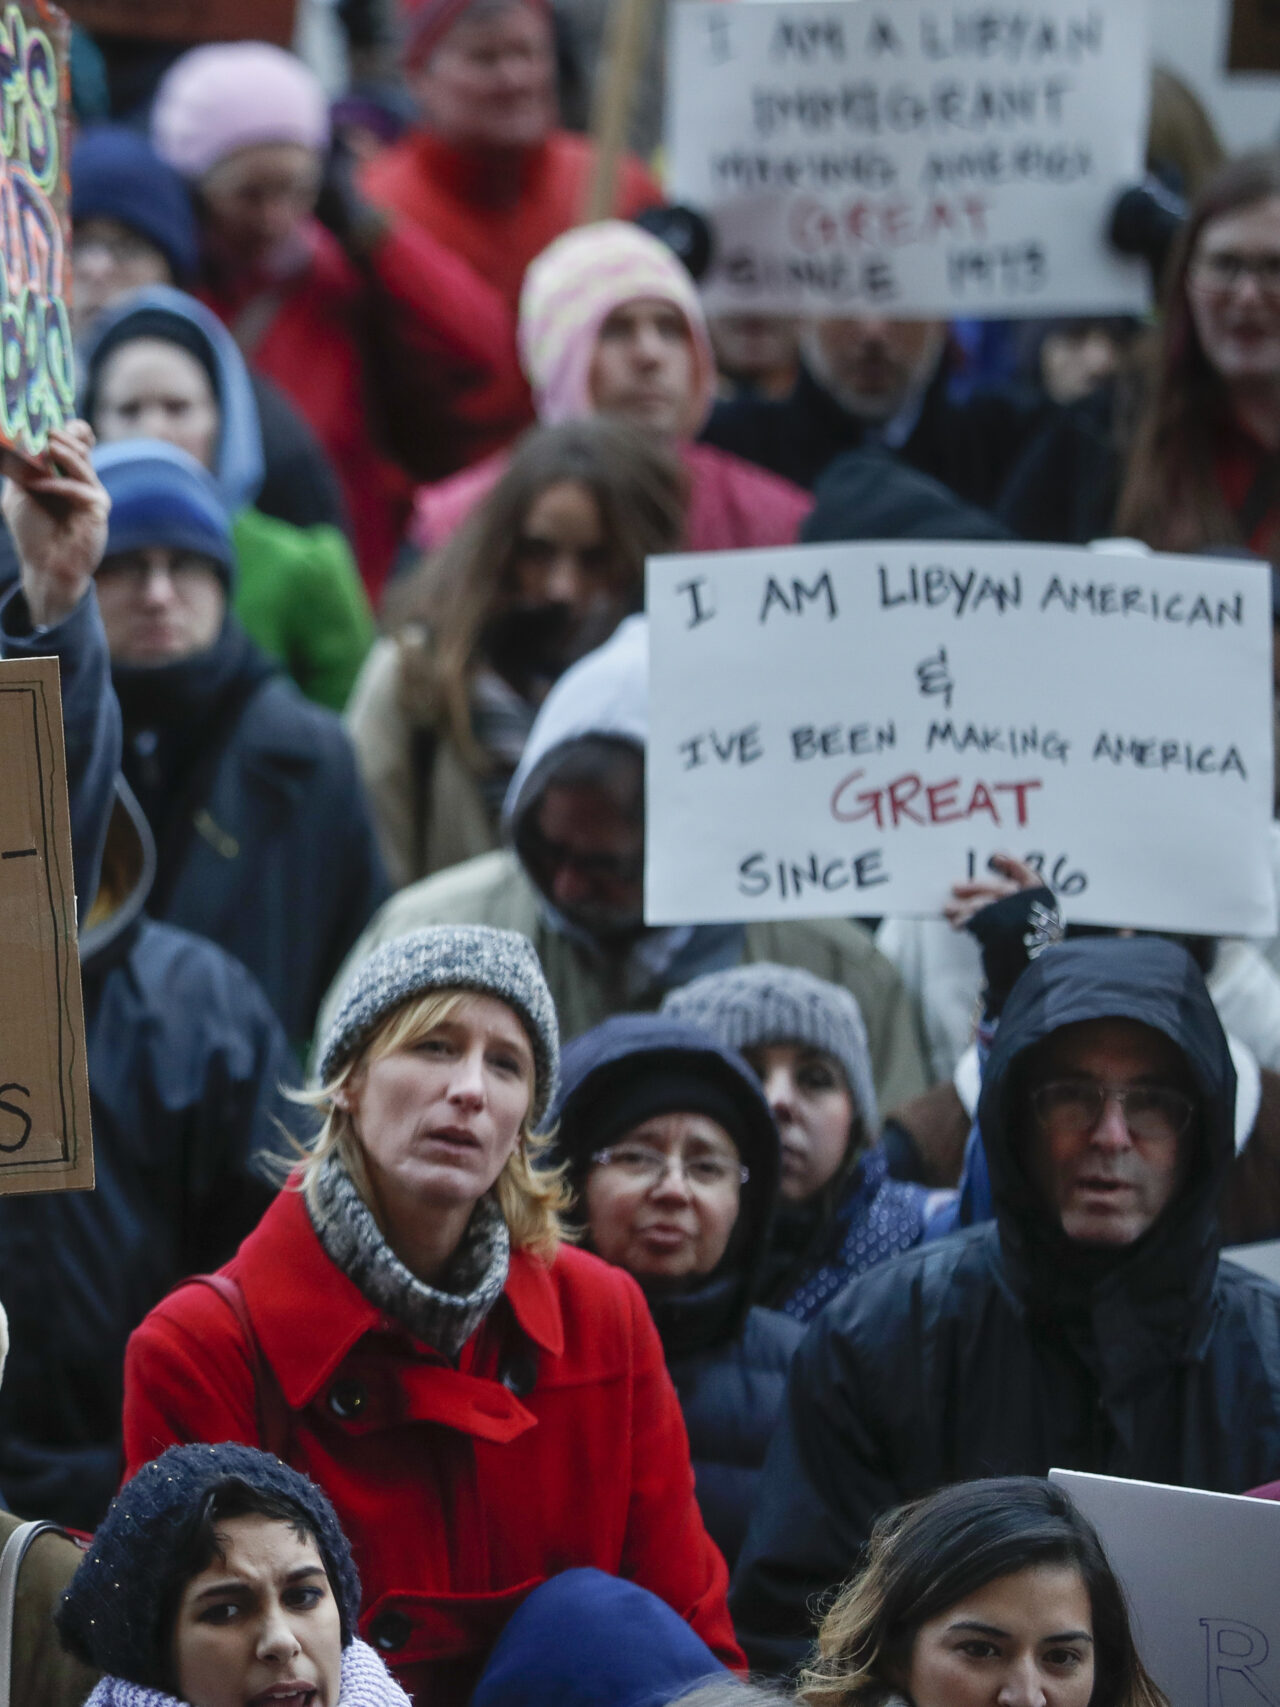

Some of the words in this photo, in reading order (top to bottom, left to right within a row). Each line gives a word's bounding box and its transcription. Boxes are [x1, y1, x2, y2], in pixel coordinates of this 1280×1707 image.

[707, 12, 734, 64] I
[769, 10, 845, 62] AM
[865, 10, 902, 60] A
[920, 5, 1104, 64] LIBYAN
[751, 73, 1072, 134] IMMIGRANT
[713, 146, 898, 189] MAKING
[924, 140, 1096, 187] AMERICA
[789, 196, 991, 250] GREAT
[722, 248, 899, 300] SINCE
[677, 575, 715, 630] I
[758, 573, 839, 625] AM
[878, 564, 1022, 619] LIBYAN
[1039, 574, 1246, 628] AMERICAN
[915, 645, 953, 708] &
[679, 723, 765, 772] IVE
[790, 721, 897, 763] BEEN
[926, 720, 1071, 764] MAKING
[1093, 731, 1248, 780] AMERICA
[831, 768, 1042, 829] GREAT
[738, 848, 890, 899] SINCE
